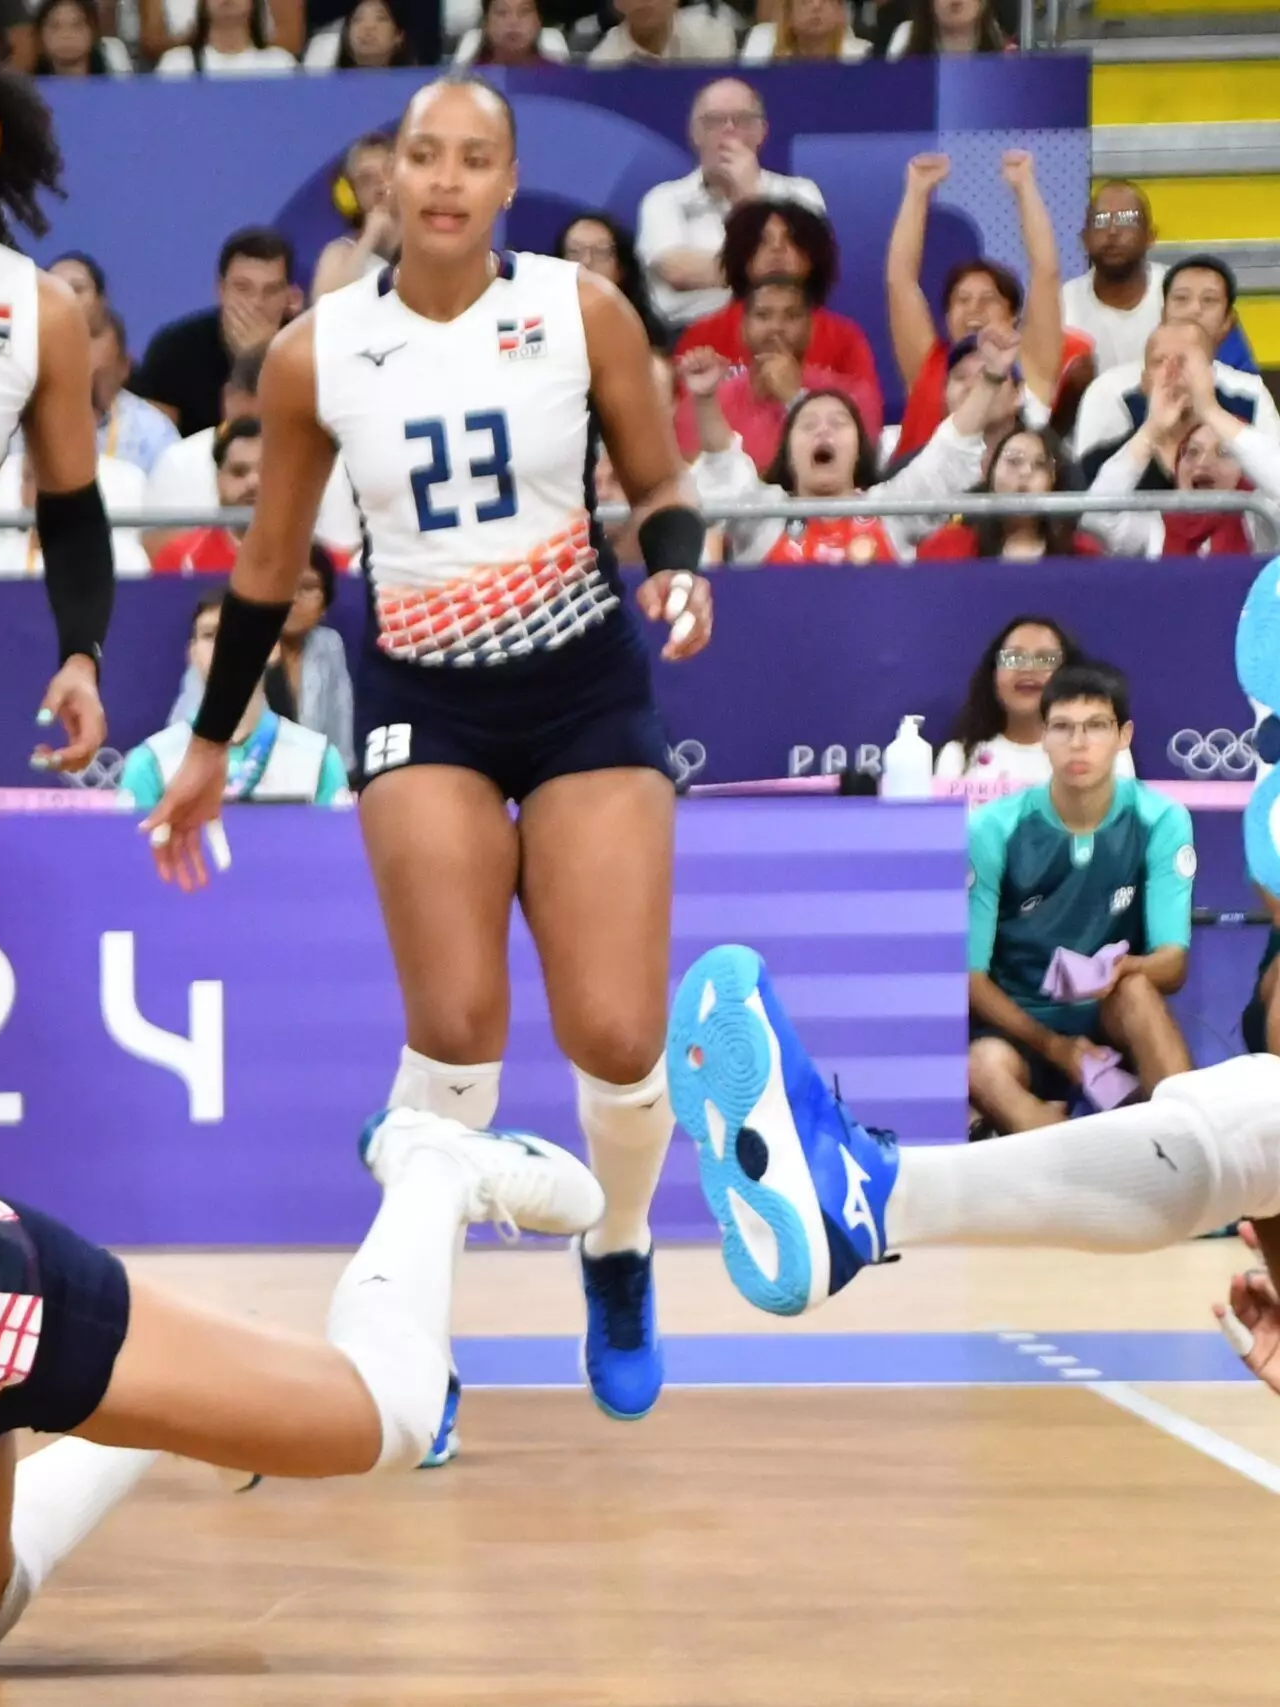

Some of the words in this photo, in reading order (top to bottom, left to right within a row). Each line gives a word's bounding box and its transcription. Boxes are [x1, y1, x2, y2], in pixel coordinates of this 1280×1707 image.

[508, 343, 542, 360] DOM
[405, 407, 518, 532] 23
[364, 723, 412, 772] 23
